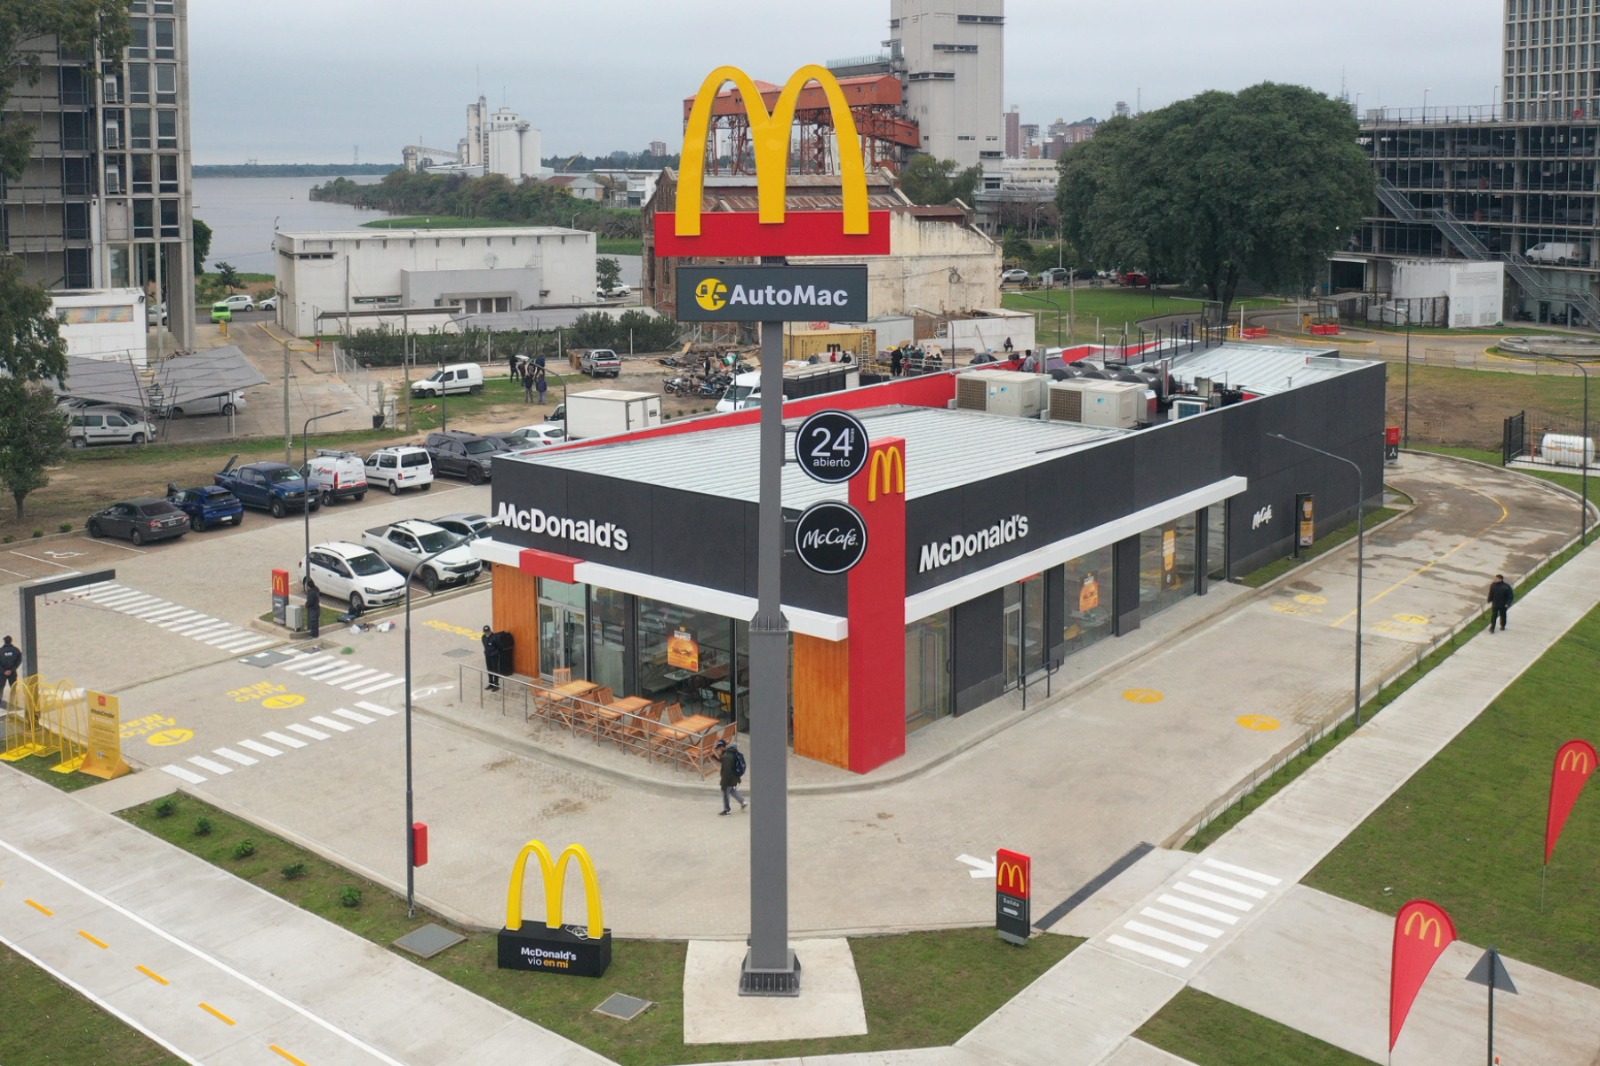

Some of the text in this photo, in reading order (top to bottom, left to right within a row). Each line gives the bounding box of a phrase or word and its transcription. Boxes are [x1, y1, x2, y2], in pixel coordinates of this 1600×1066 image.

[729, 284, 848, 306] AutoMac
[811, 427, 853, 457] 24
[813, 458, 850, 467] abierto
[498, 501, 629, 551] McDonald's
[802, 527, 857, 550] McCafé
[919, 514, 1029, 573] McDonald's
[521, 947, 577, 961] McDonald's
[528, 957, 542, 966] vio
